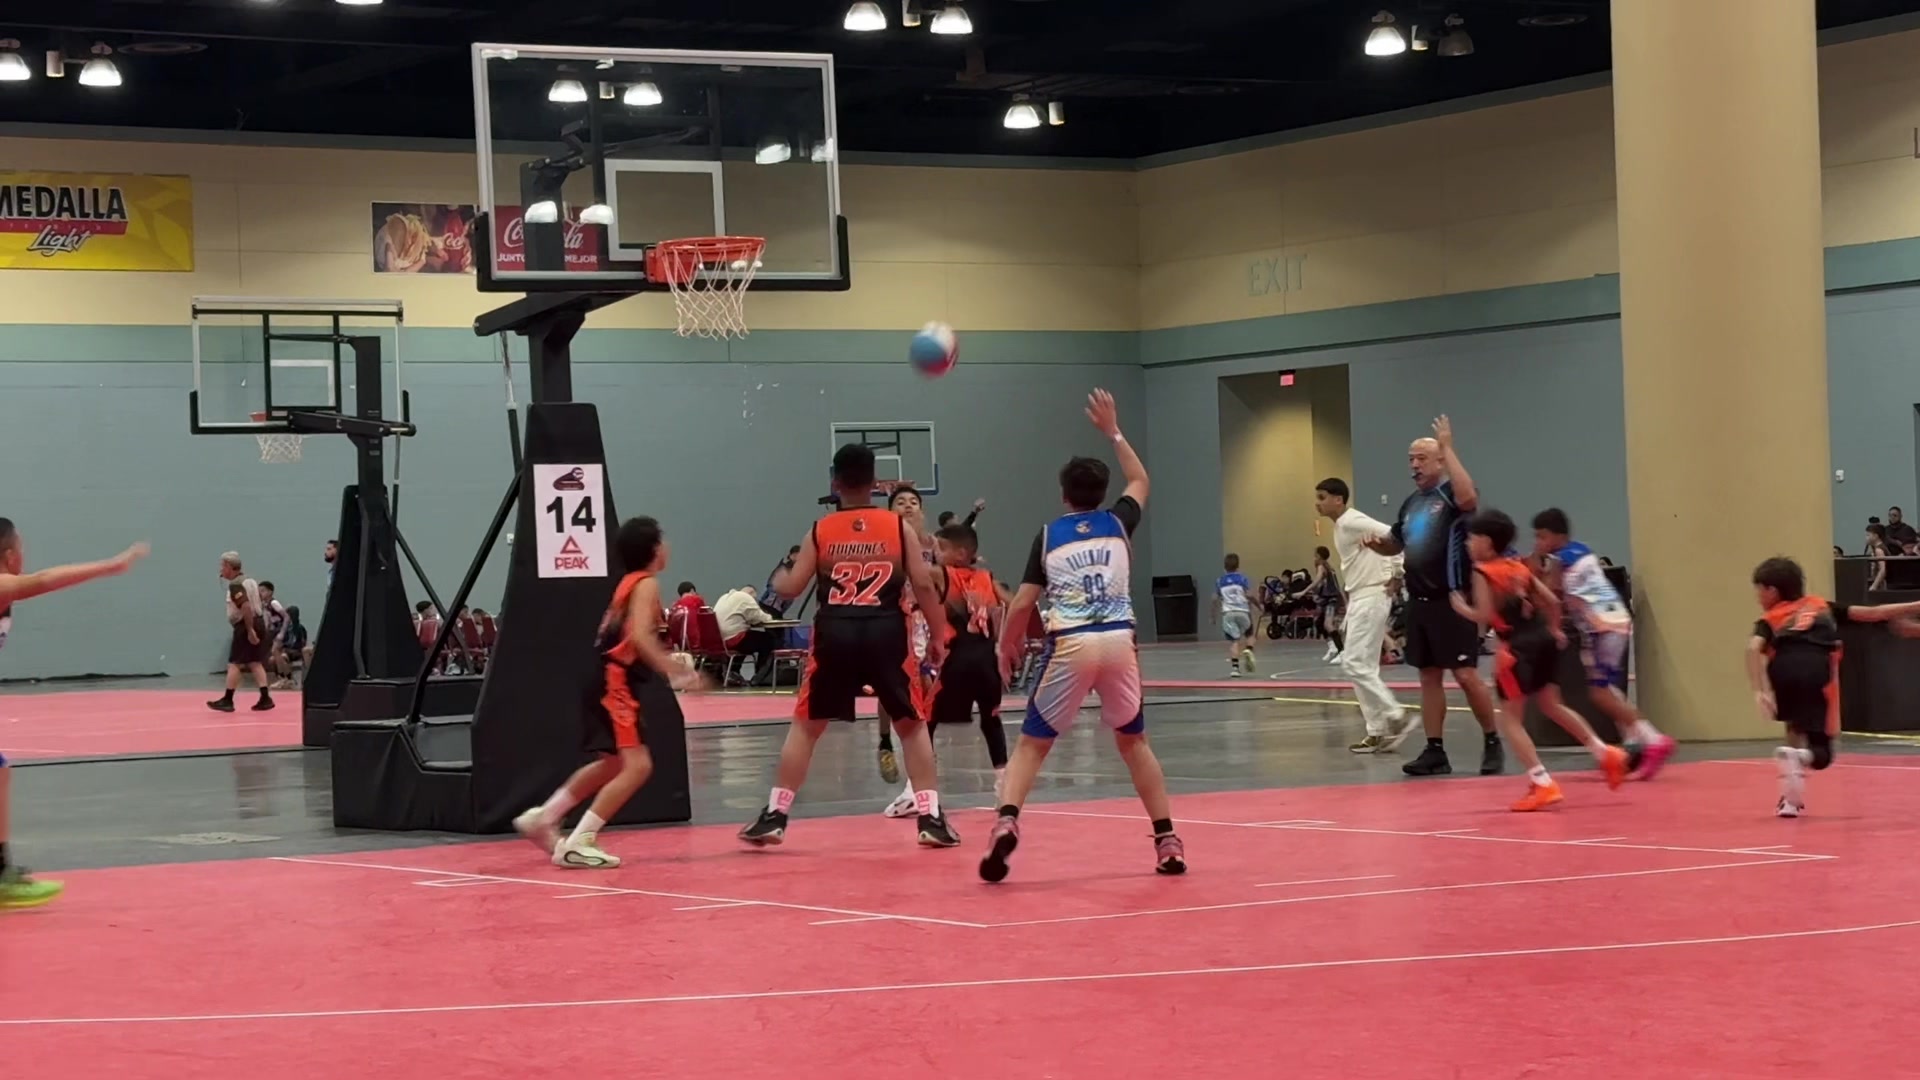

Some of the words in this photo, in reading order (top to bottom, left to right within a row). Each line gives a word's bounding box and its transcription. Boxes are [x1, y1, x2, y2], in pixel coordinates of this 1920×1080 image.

[26, 224, 92, 257] Light
[564, 254, 598, 264] MEJOR
[1249, 254, 1308, 296] EXIT
[546, 496, 597, 534] 14
[554, 556, 590, 570] PEAK
[828, 561, 893, 606] 32
